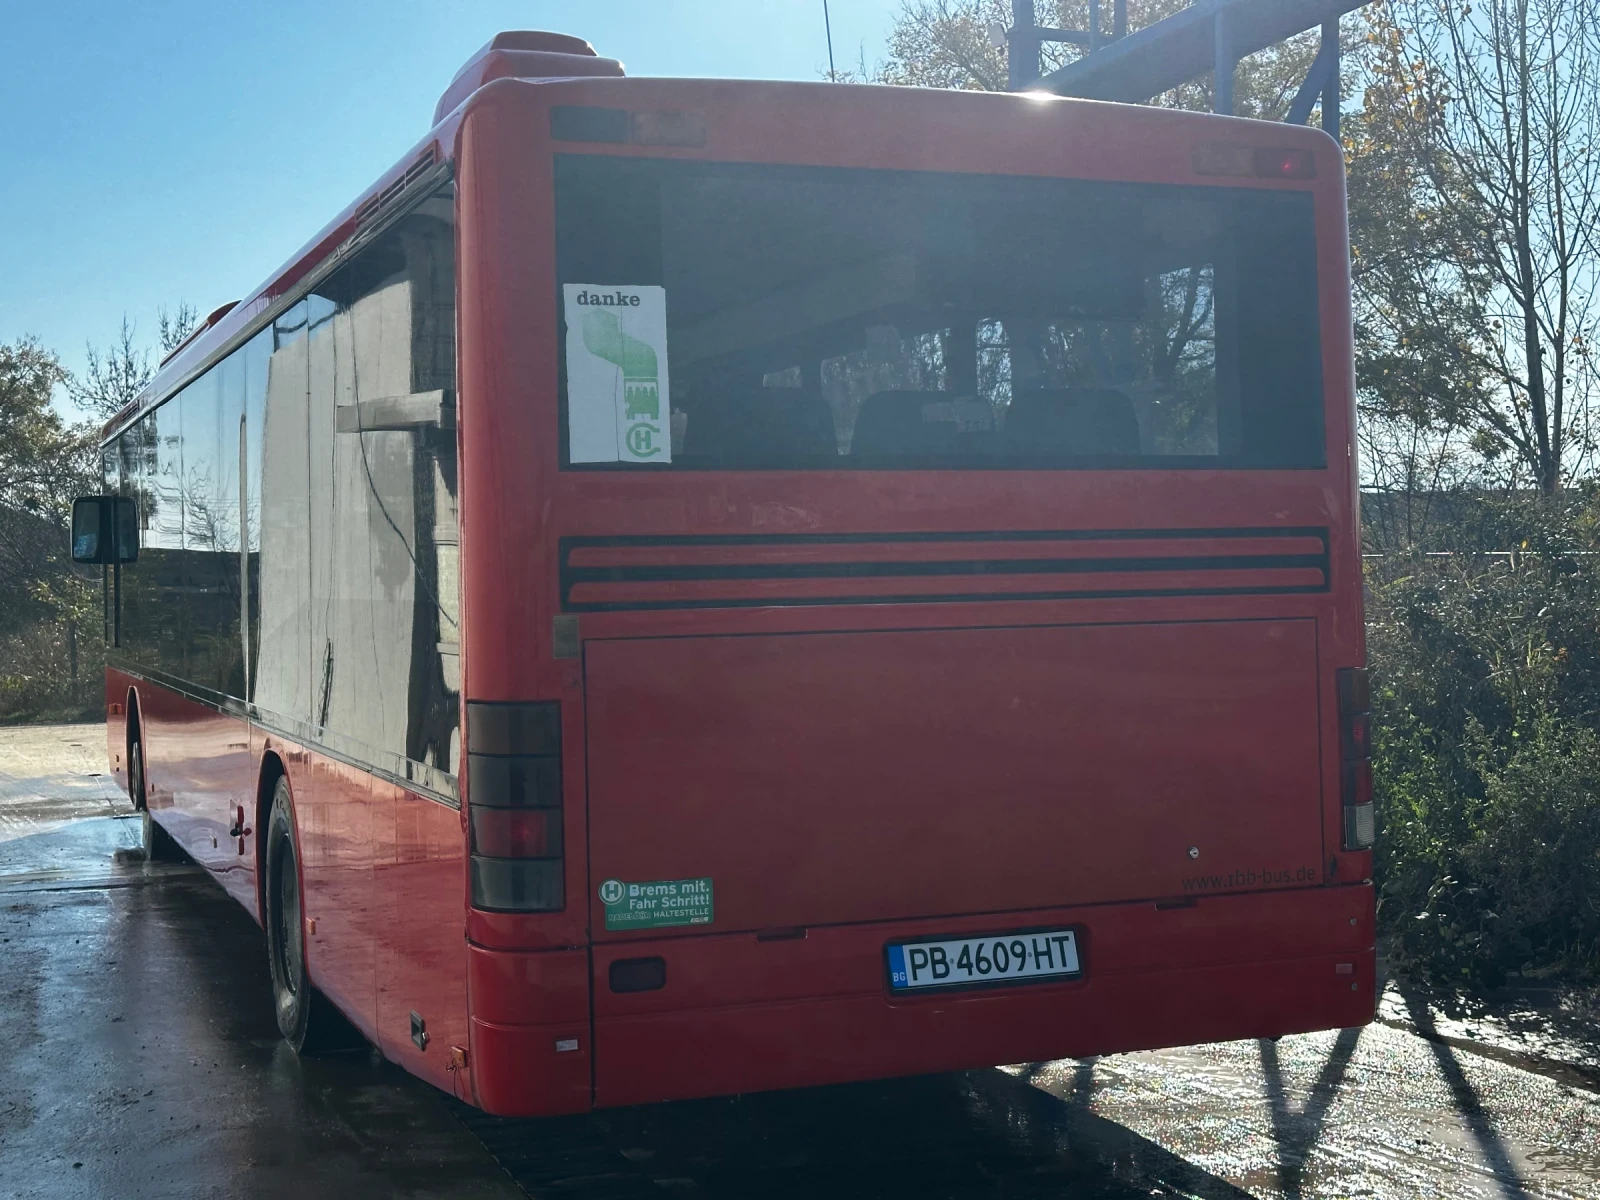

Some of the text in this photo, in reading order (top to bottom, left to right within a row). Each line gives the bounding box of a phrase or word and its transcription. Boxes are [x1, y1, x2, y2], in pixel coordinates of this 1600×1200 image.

[576, 290, 641, 307] danke
[634, 430, 651, 450] H
[1181, 866, 1316, 892] www.rbb-bus.de
[604, 883, 620, 902] H
[629, 880, 710, 897] Brems mit.
[629, 894, 710, 910] Fahr Schritt!
[653, 907, 710, 918] HALTESTELLE
[892, 972, 906, 982] BG
